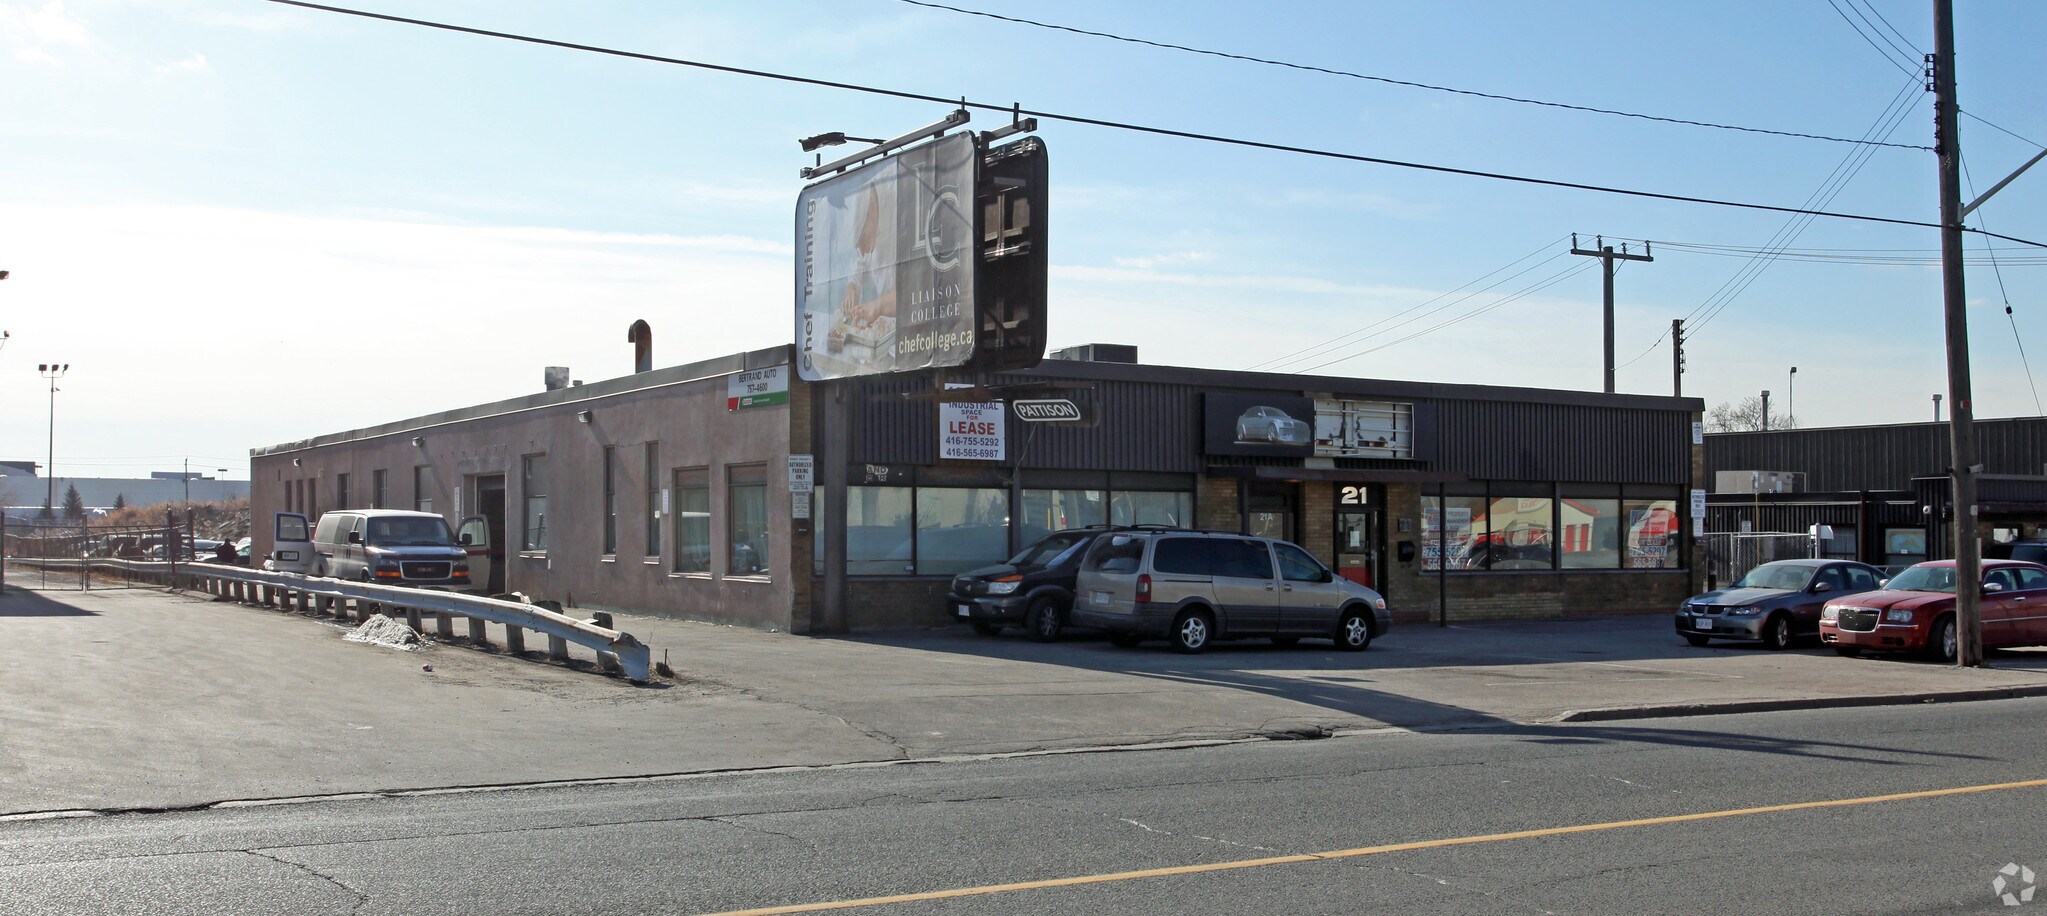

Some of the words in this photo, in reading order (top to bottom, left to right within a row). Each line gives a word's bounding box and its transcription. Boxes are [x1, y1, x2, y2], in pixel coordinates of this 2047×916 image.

[804, 198, 816, 303] Training
[911, 283, 961, 305] LIAISON
[911, 302, 961, 323] COLLEGE
[803, 312, 813, 371] Chef
[898, 330, 973, 354] chefcollege.ca
[739, 371, 762, 383] BERTRAND
[764, 369, 777, 379] AUTO
[949, 402, 999, 410] INDUSTRIAL
[1017, 404, 1076, 417] PATTISON
[949, 421, 996, 436] LEASE
[945, 436, 999, 447] 416-755-5292
[946, 448, 999, 458] 416-565-6987
[1341, 486, 1367, 504] 21
[1259, 512, 1274, 521] 21A
